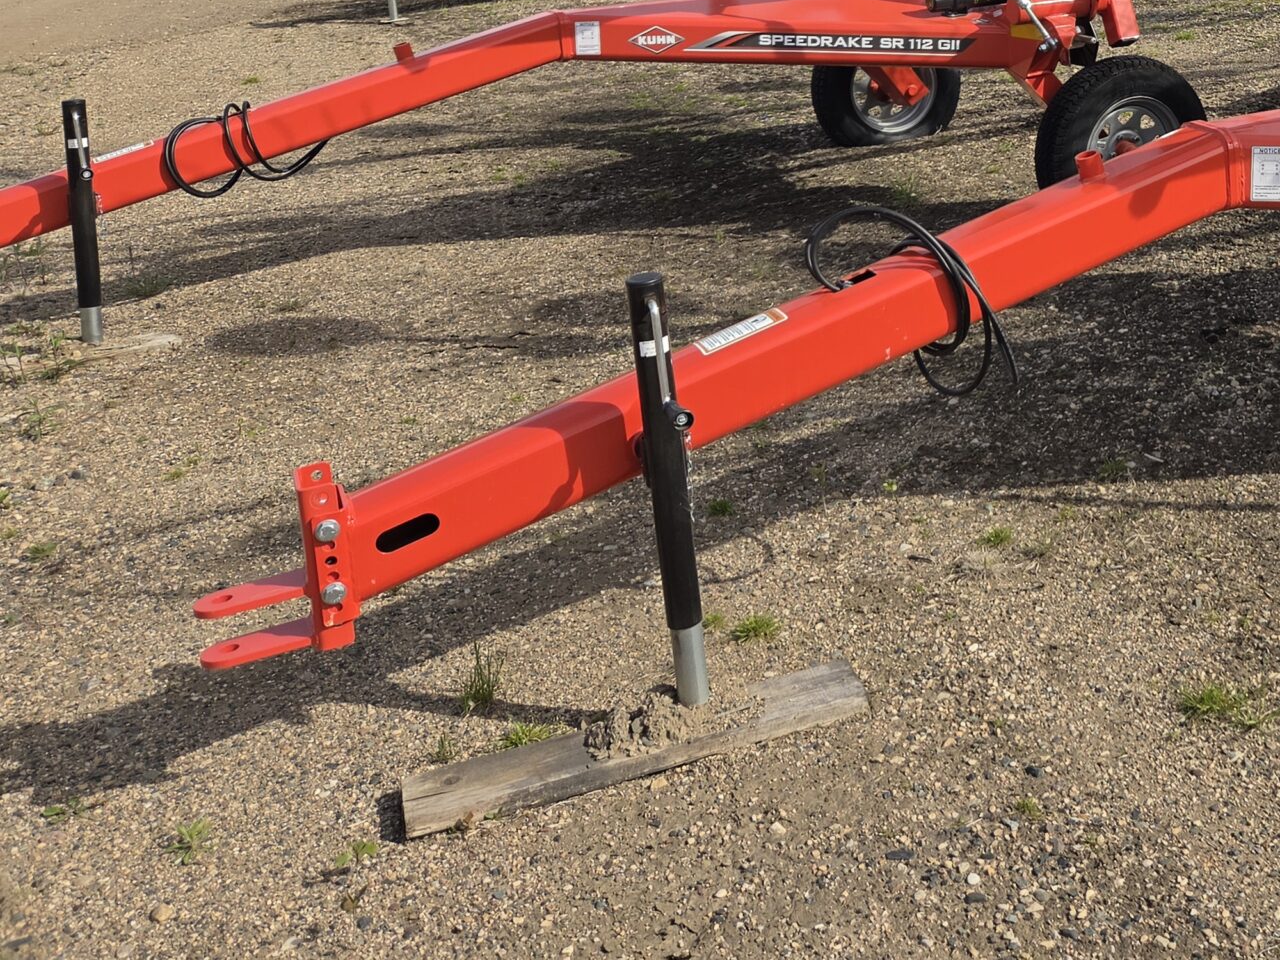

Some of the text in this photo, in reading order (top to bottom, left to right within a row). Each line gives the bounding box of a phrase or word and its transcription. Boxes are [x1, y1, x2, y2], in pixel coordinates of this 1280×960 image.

[638, 35, 676, 46] KUHN
[758, 34, 960, 50] SPEEDRAKE SR 112 GII
